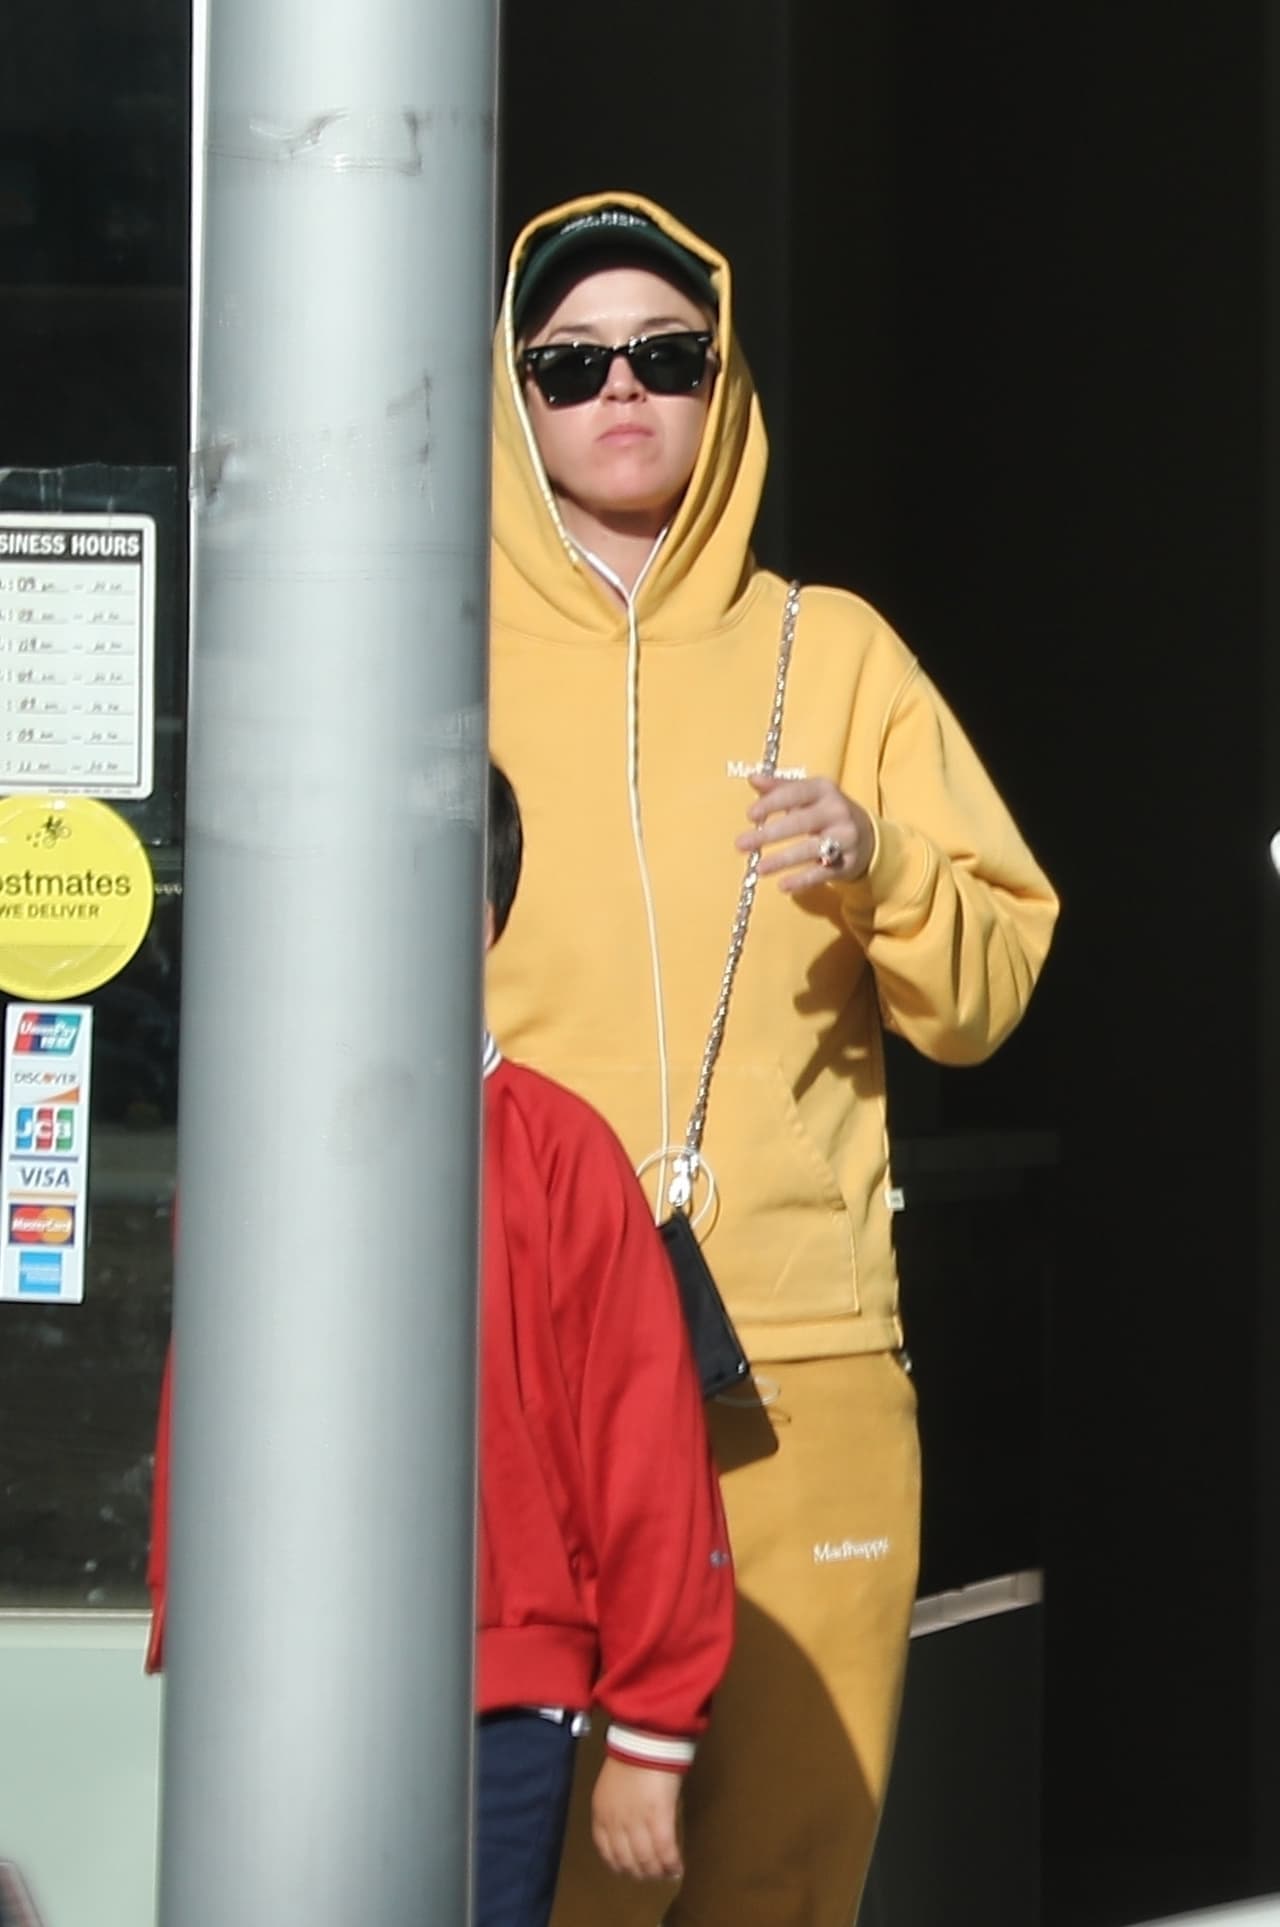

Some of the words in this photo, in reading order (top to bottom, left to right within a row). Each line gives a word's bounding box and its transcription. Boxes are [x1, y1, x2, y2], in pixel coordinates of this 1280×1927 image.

[71, 533, 140, 556] HOURS
[0, 869, 131, 896] stmates
[28, 904, 100, 918] DELIVER
[21, 1167, 70, 1188] VISA
